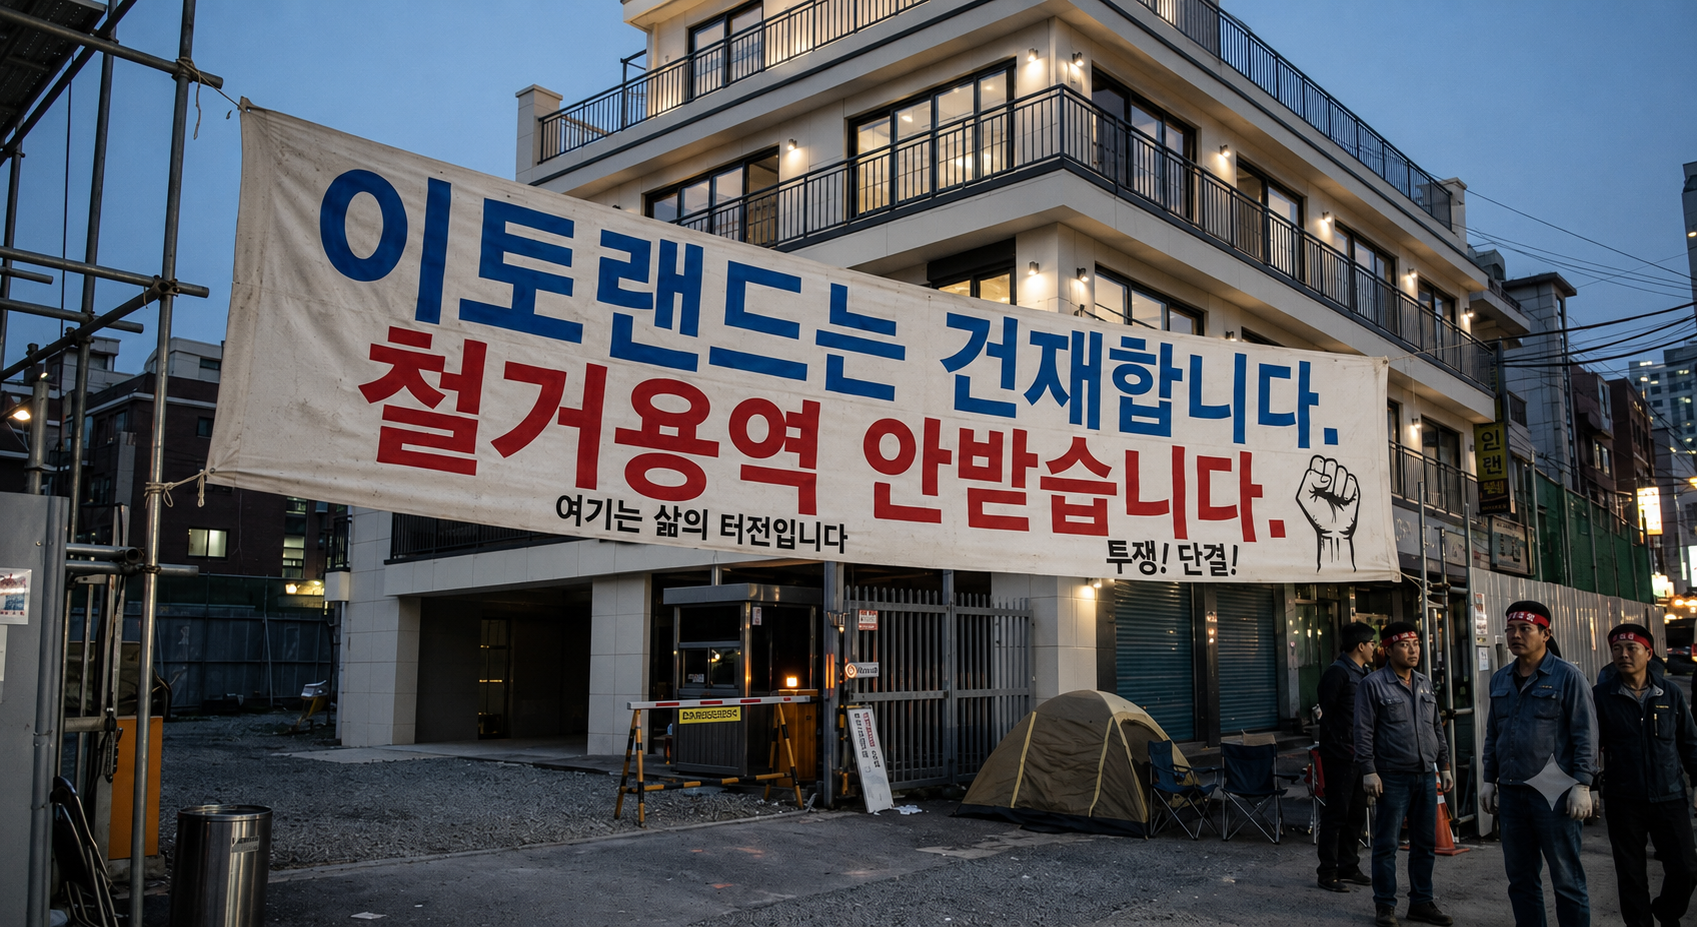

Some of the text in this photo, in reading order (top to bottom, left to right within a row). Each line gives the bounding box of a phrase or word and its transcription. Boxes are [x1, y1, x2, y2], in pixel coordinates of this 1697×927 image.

[318, 168, 1339, 449] 이토랜드는 건재합니다.
[359, 326, 1287, 543] 철거용역 안받습니다.
[555, 494, 849, 554] 여기는 삶의 터전입니다
[1106, 540, 1239, 577] 투쟁! 단결!
